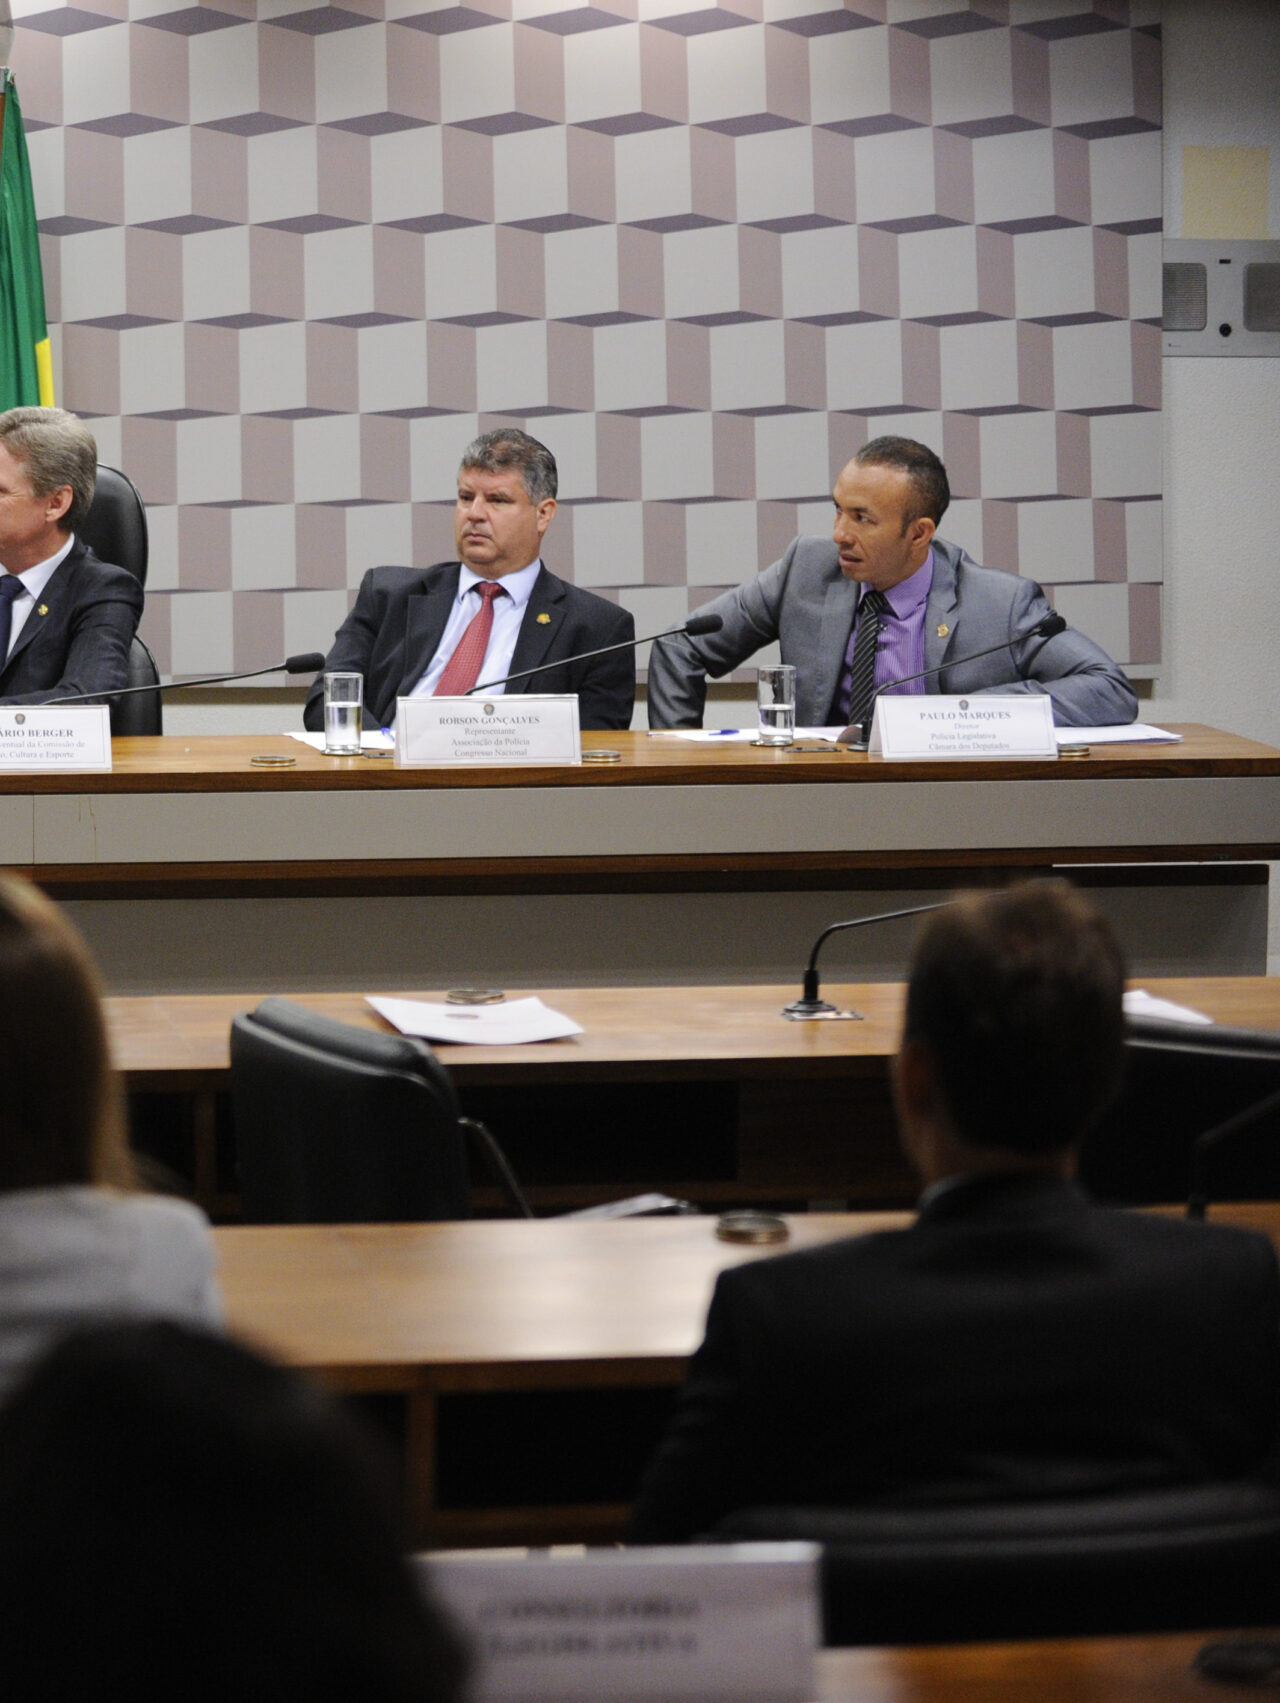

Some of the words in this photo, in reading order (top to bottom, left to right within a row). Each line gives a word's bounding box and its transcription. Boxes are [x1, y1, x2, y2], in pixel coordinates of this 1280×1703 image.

[920, 711, 956, 720] PAULO
[958, 711, 1012, 721] MARQUES
[439, 716, 479, 725] ROBSON
[481, 716, 540, 726] GONÇALVES
[28, 729, 74, 738] BERGER
[76, 740, 85, 748] de
[494, 738, 503, 746] da
[495, 749, 528, 757] Nacional
